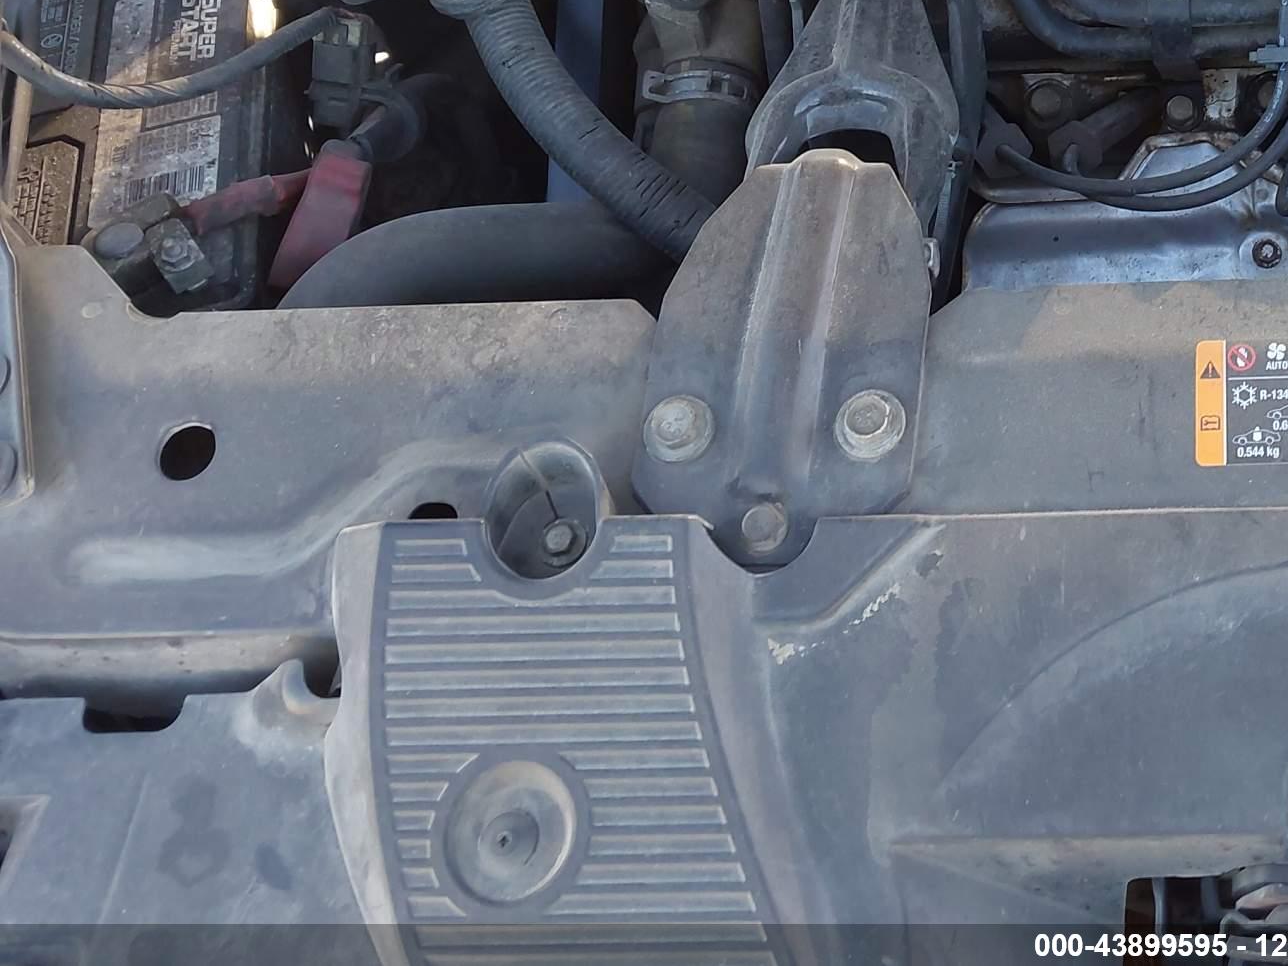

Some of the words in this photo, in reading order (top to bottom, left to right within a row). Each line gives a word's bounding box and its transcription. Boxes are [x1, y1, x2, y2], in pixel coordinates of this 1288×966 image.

[1265, 360, 1288, 371] AUTO
[1236, 446, 1265, 458] 0.544
[1266, 445, 1280, 459] kg
